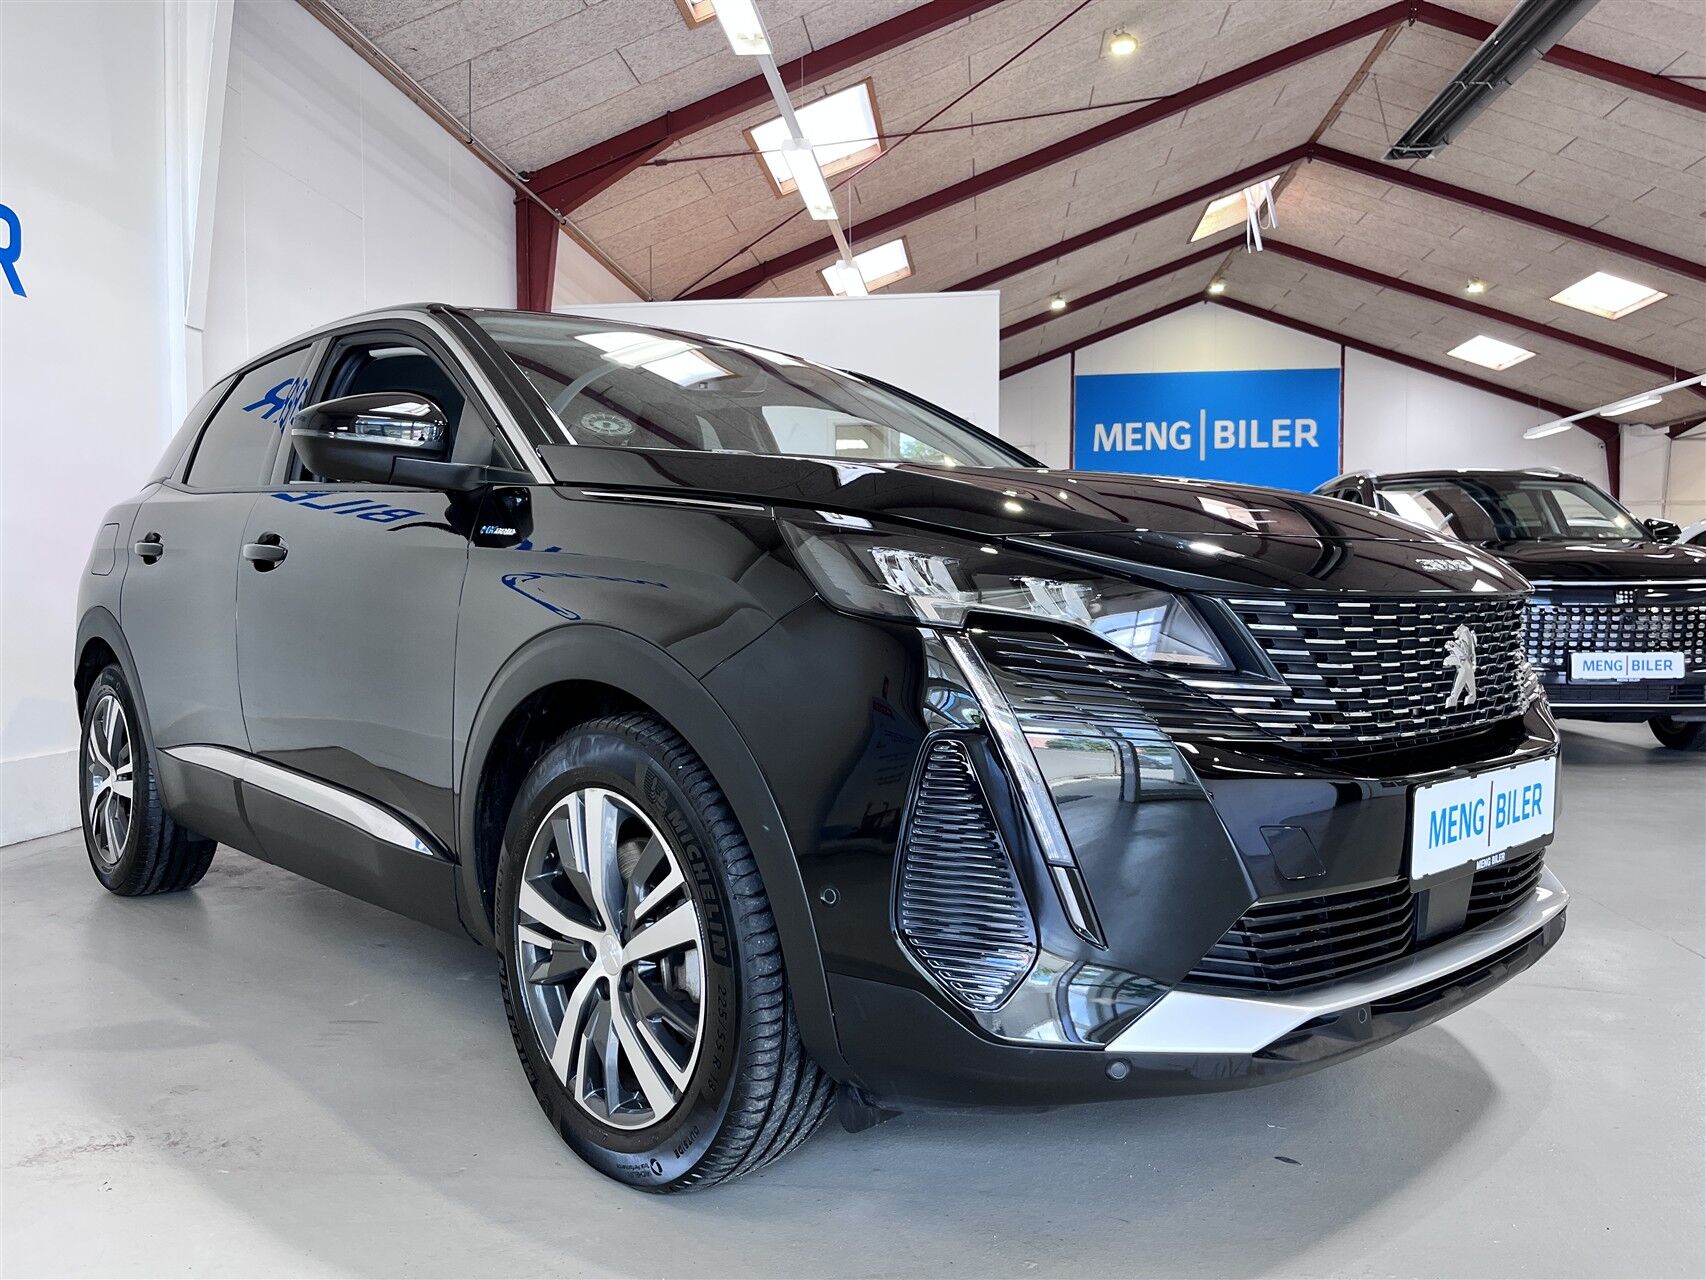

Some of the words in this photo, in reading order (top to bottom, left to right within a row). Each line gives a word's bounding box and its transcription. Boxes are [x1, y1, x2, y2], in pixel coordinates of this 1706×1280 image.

[1093, 420, 1191, 452] MENG
[1213, 418, 1319, 450] BILER
[1582, 660, 1623, 671] MENG
[1631, 659, 1673, 671] BILER
[1428, 798, 1485, 849] MENG
[1495, 783, 1542, 829] BILER
[667, 808, 730, 958] MICHELIN
